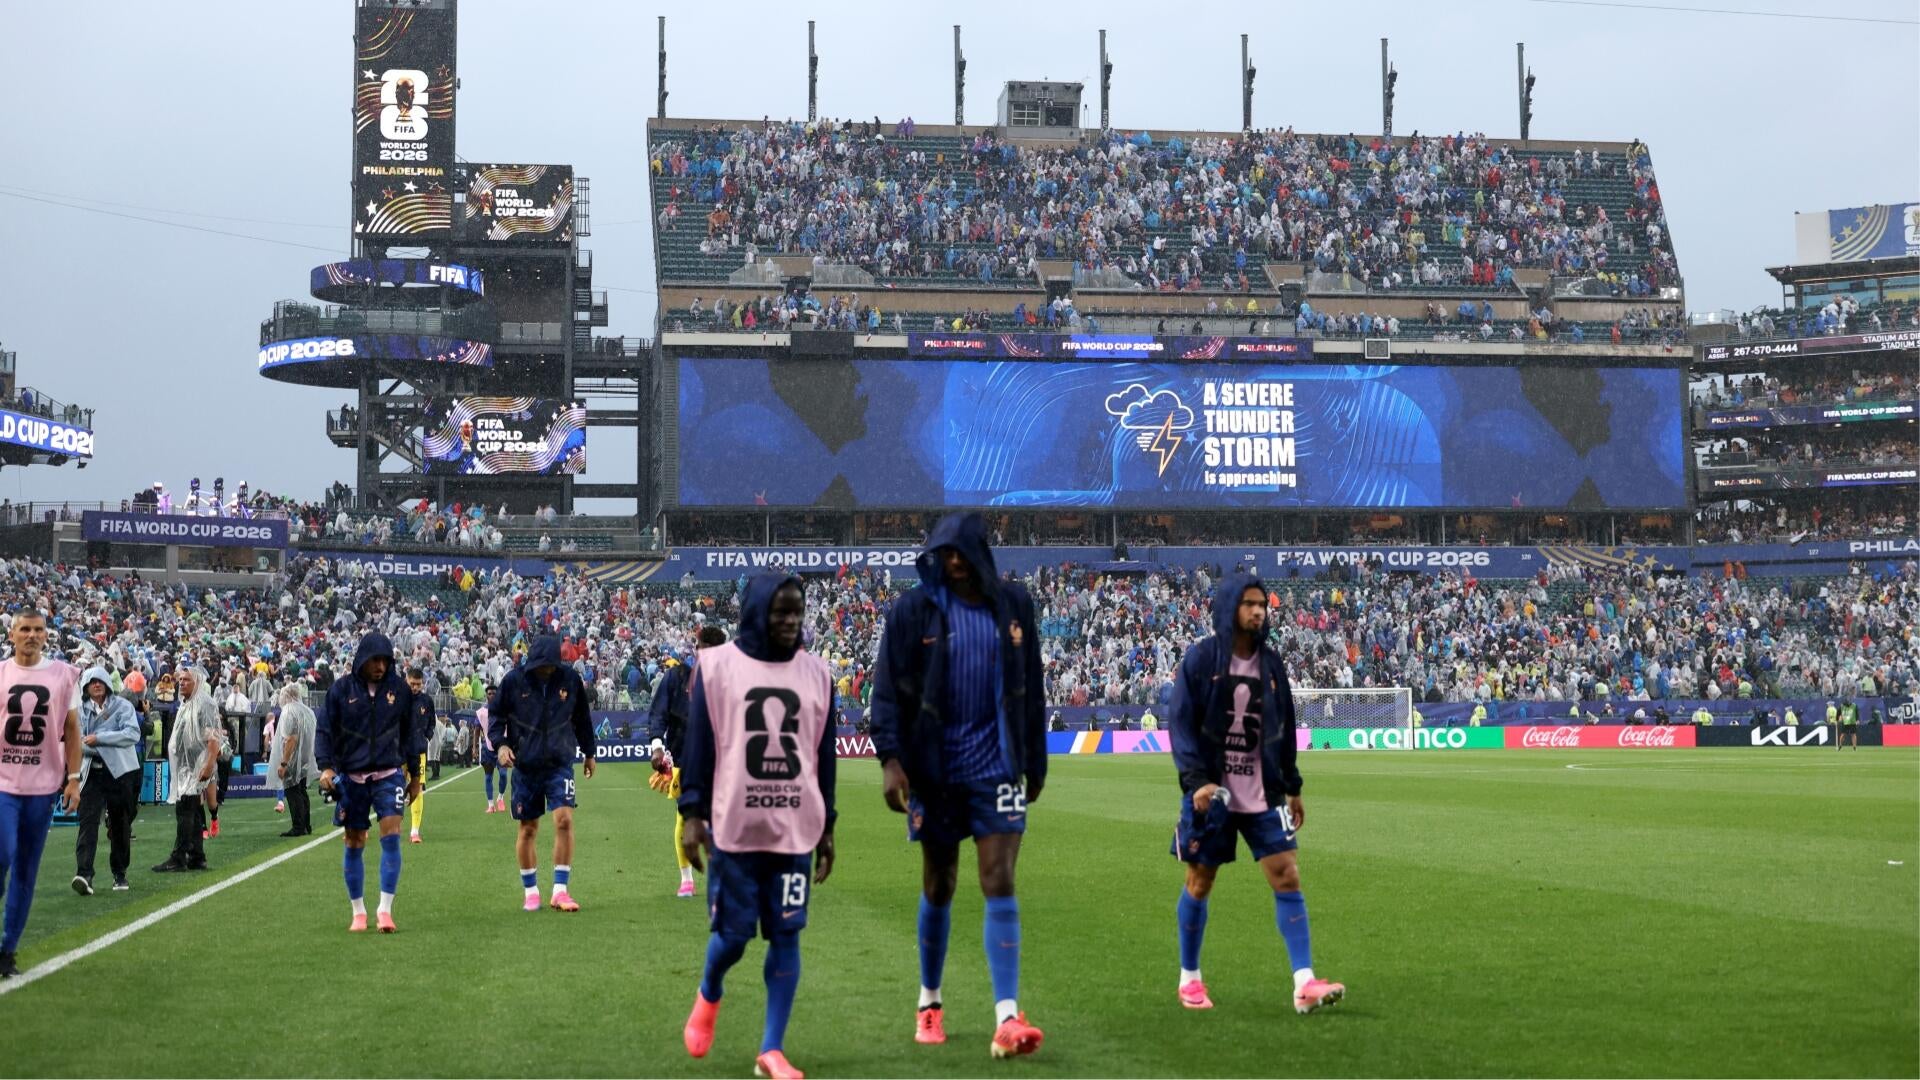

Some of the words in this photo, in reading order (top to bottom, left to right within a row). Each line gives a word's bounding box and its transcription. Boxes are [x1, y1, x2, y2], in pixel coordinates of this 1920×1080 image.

[394, 125, 416, 133] FIFA
[379, 149, 428, 161] 2026
[363, 166, 444, 176] PHILADELPHIA
[495, 189, 519, 198] FIFA
[495, 199, 534, 208] WORLD
[495, 208, 517, 217] CUP
[517, 208, 555, 217] 2026
[430, 265, 465, 285] FIFA
[1862, 334, 1897, 344] STADIUM
[1898, 333, 1908, 341] AS
[267, 344, 290, 364] CUP
[290, 339, 355, 359] 2026
[1062, 342, 1081, 350] FIFA
[1082, 342, 1114, 351] WORLD
[1115, 343, 1132, 351] CUP
[1734, 344, 1798, 357] 267-570-4444
[1881, 341, 1915, 350] STADIUM
[1203, 383, 1216, 406] A
[1221, 383, 1295, 406] SEVERE
[1824, 410, 1840, 418] FIFA
[1840, 408, 1868, 417] WORLD
[1869, 407, 1885, 415] CUP
[477, 419, 505, 429] FIFA
[1204, 410, 1295, 433] THUNDER
[17, 418, 49, 446] CUP
[50, 425, 94, 455] 202
[476, 430, 523, 441] WORLD
[476, 441, 503, 452] CUP
[1204, 437, 1296, 467] STORM
[1218, 471, 1297, 487] approaching
[1827, 473, 1843, 482] FIFA
[1844, 472, 1873, 481] WORLD
[1873, 471, 1888, 479] CUP
[100, 519, 133, 534] FIFA
[134, 520, 188, 536] WORLD
[191, 523, 220, 537] CUP
[222, 525, 272, 540] 2026
[1850, 539, 1920, 553] PHILA
[706, 551, 748, 567] FIFA
[751, 551, 822, 567] WORLD
[825, 551, 864, 567] CUP
[866, 551, 918, 566] 202
[1277, 551, 1316, 566] FFA
[1388, 551, 1424, 566] CUP
[1427, 551, 1490, 566] 2026
[16, 733, 34, 741] FIFA
[1348, 728, 1467, 749] aramco
[2, 754, 41, 766] 2026
[762, 761, 790, 774] FIFA
[1224, 764, 1255, 776] 026
[565, 779, 576, 797] 19
[745, 784, 782, 793] WORLD
[784, 785, 802, 794] CUP
[745, 794, 802, 809] 2026
[781, 873, 807, 907] 13
